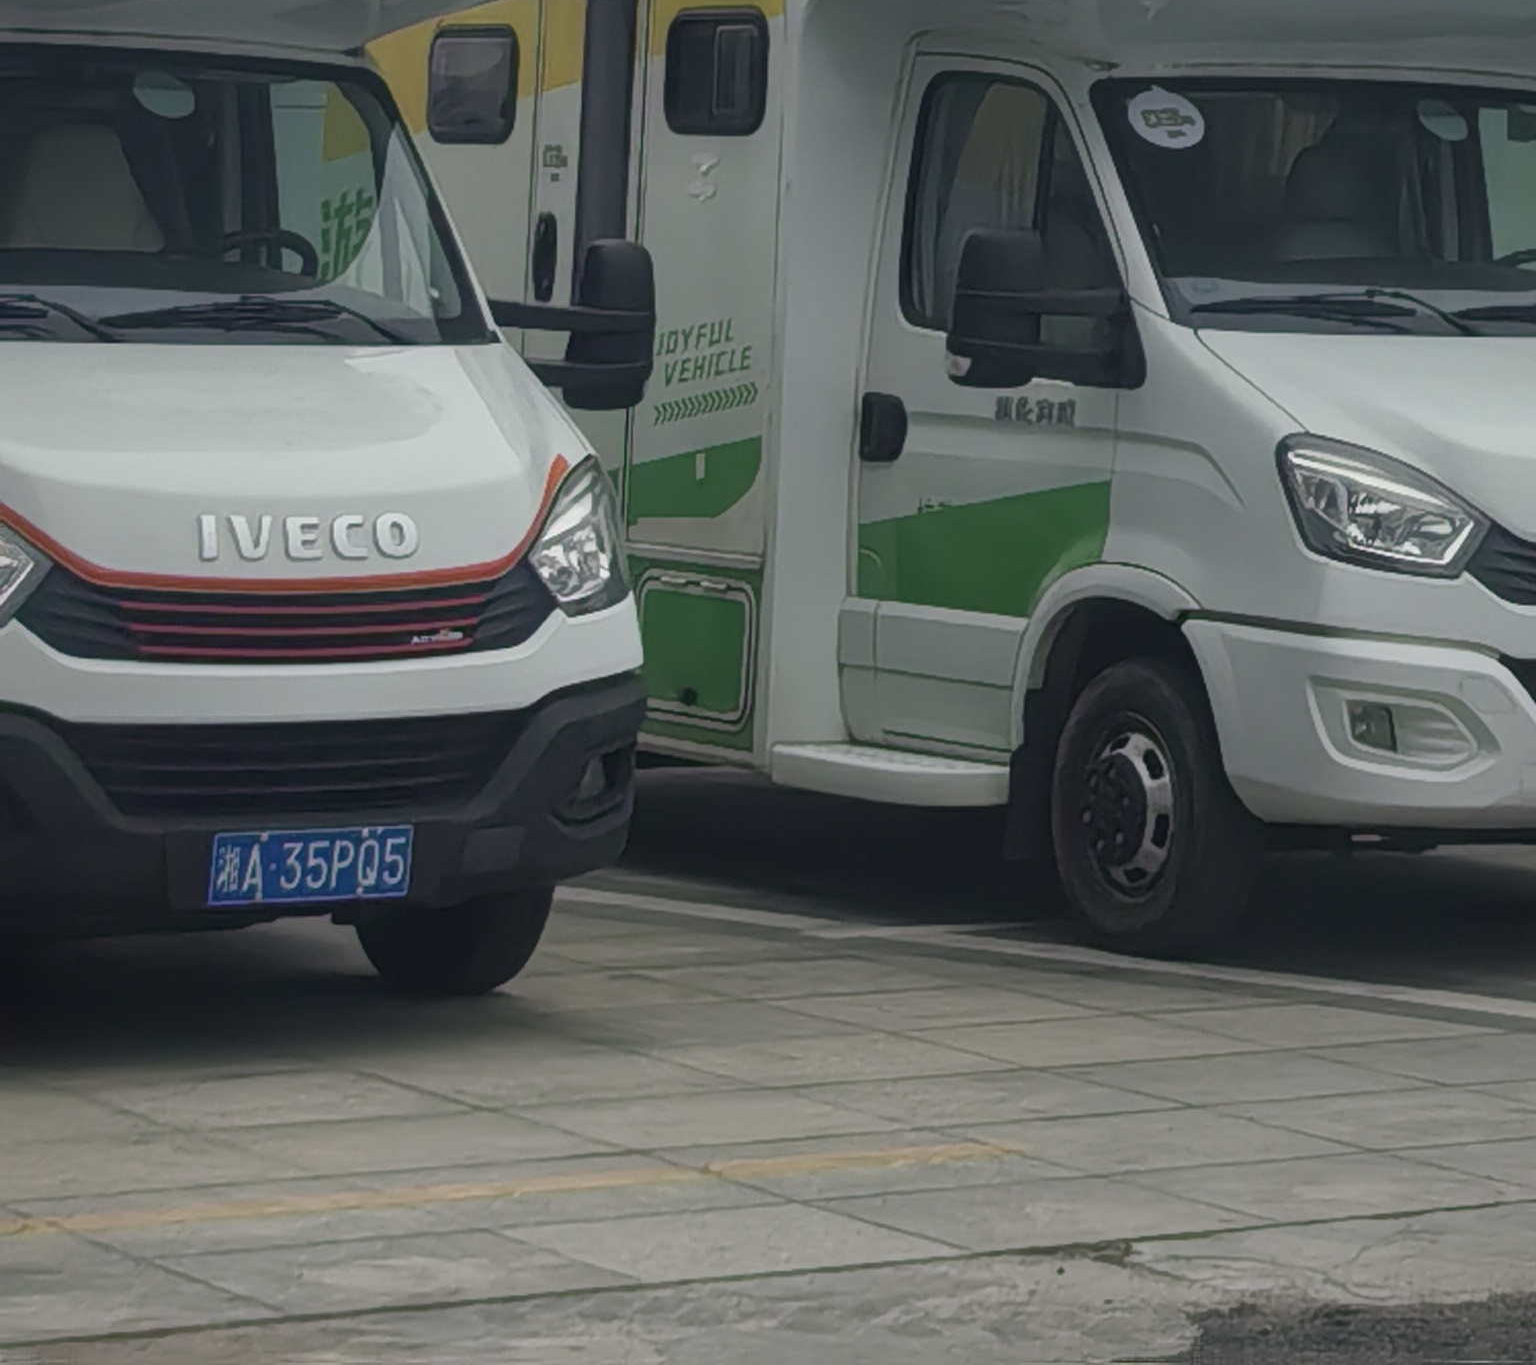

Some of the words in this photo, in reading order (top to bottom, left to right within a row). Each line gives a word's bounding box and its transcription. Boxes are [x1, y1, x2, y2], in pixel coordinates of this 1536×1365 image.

[656, 318, 734, 356] JOYFUL
[665, 345, 752, 387] VEHICLE
[199, 512, 419, 562] IVECO
